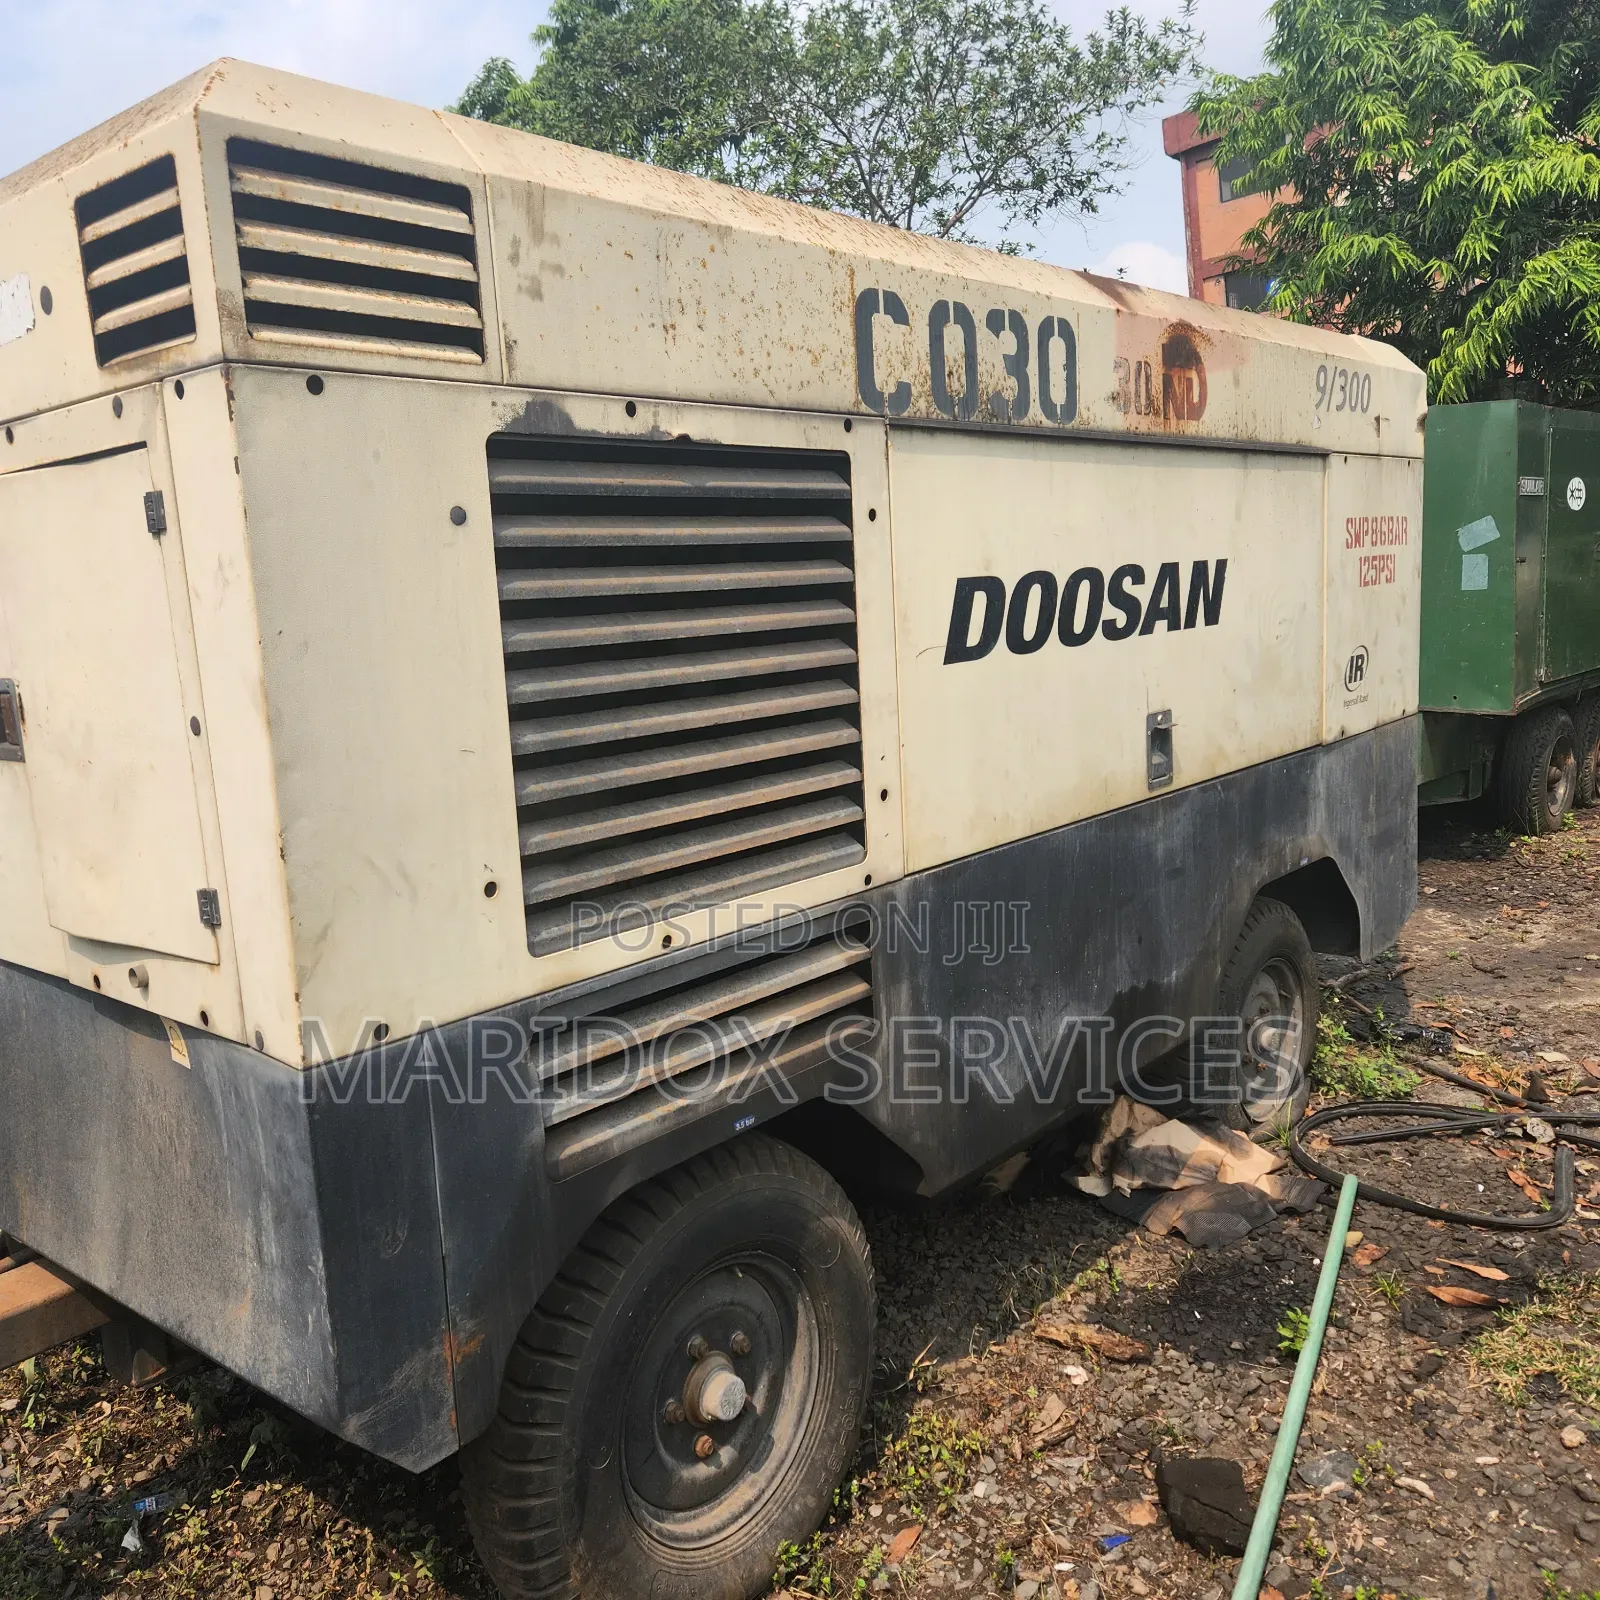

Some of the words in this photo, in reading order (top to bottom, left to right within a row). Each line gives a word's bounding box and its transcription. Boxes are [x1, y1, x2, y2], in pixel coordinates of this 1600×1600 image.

[1315, 364, 1372, 414] 9/300
[1345, 516, 1370, 550] SWP
[1358, 553, 1396, 588] 125PSI
[943, 558, 1228, 665] DOOSAN
[1348, 653, 1365, 685] IR
